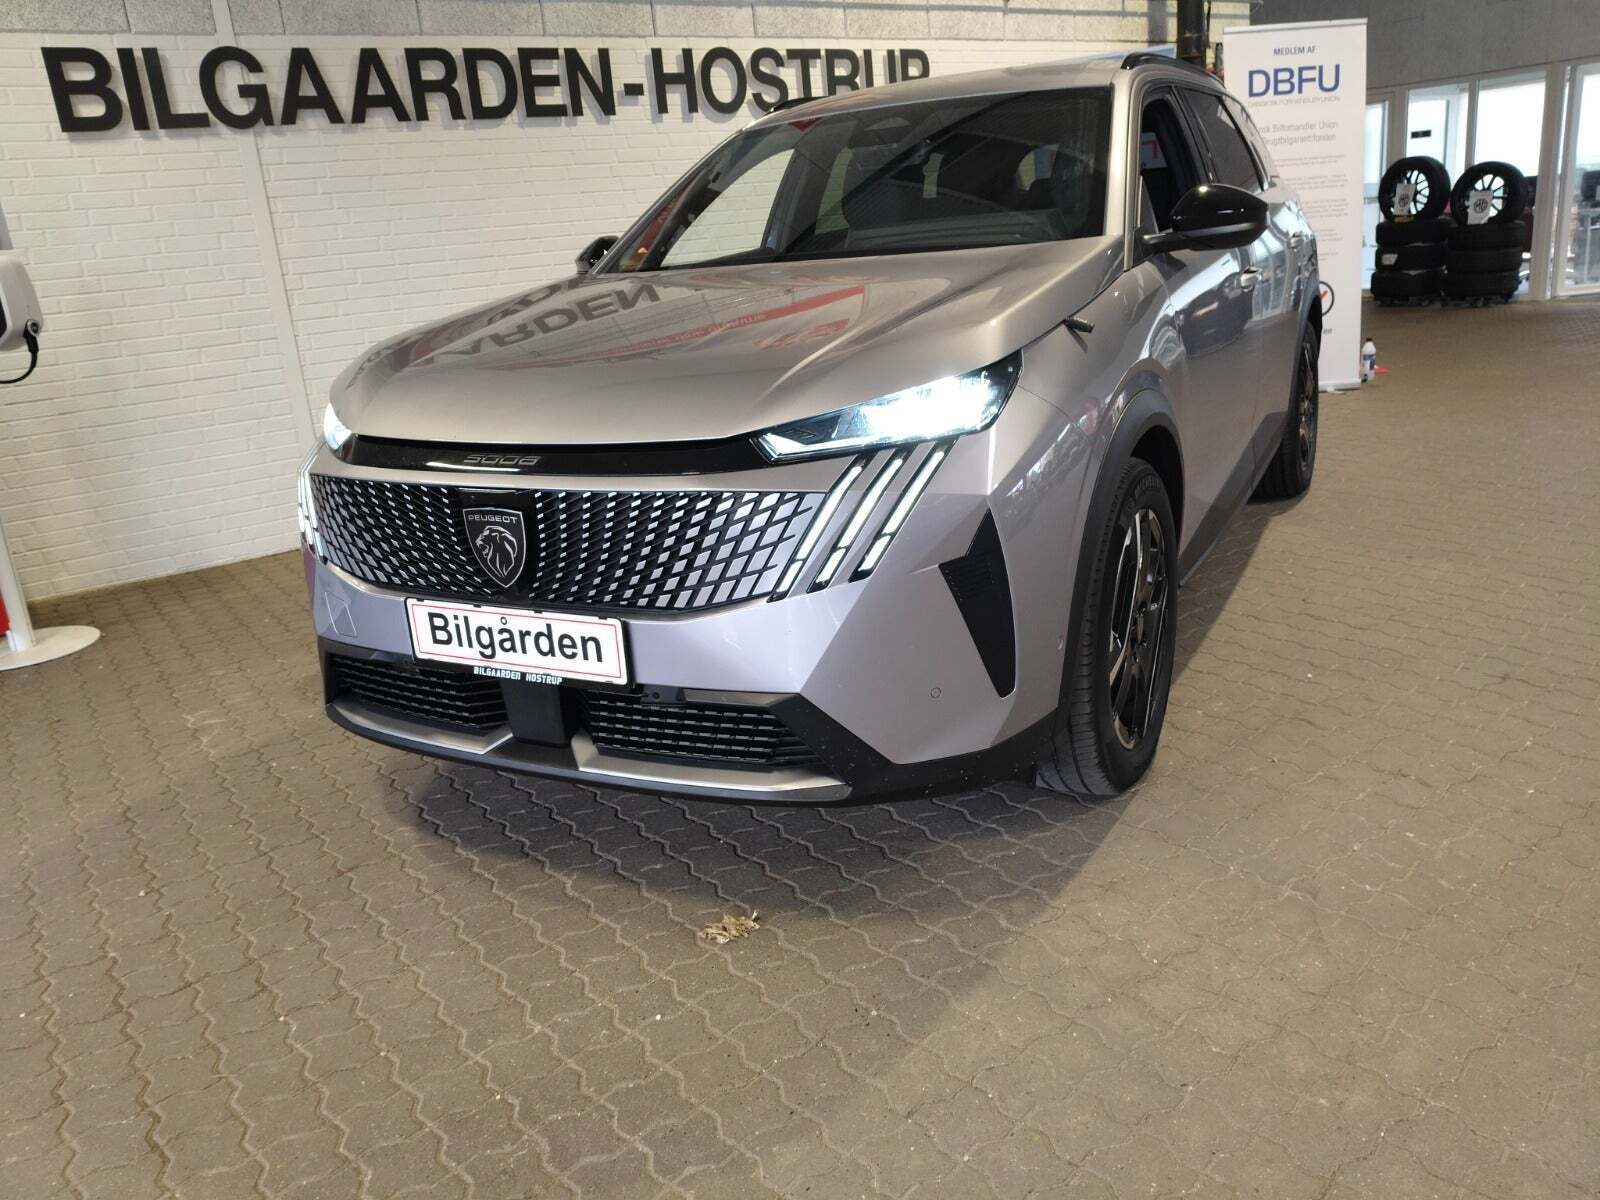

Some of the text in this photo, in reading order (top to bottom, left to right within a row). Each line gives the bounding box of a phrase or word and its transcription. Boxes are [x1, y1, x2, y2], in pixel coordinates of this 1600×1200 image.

[1273, 45, 1317, 56] MEDLEM AF
[1248, 64, 1340, 98] DBFU
[463, 454, 542, 465] 5008
[467, 514, 518, 524] PEUGEOT
[427, 611, 603, 663] Bilgården
[525, 673, 562, 685] HOSTRUP
